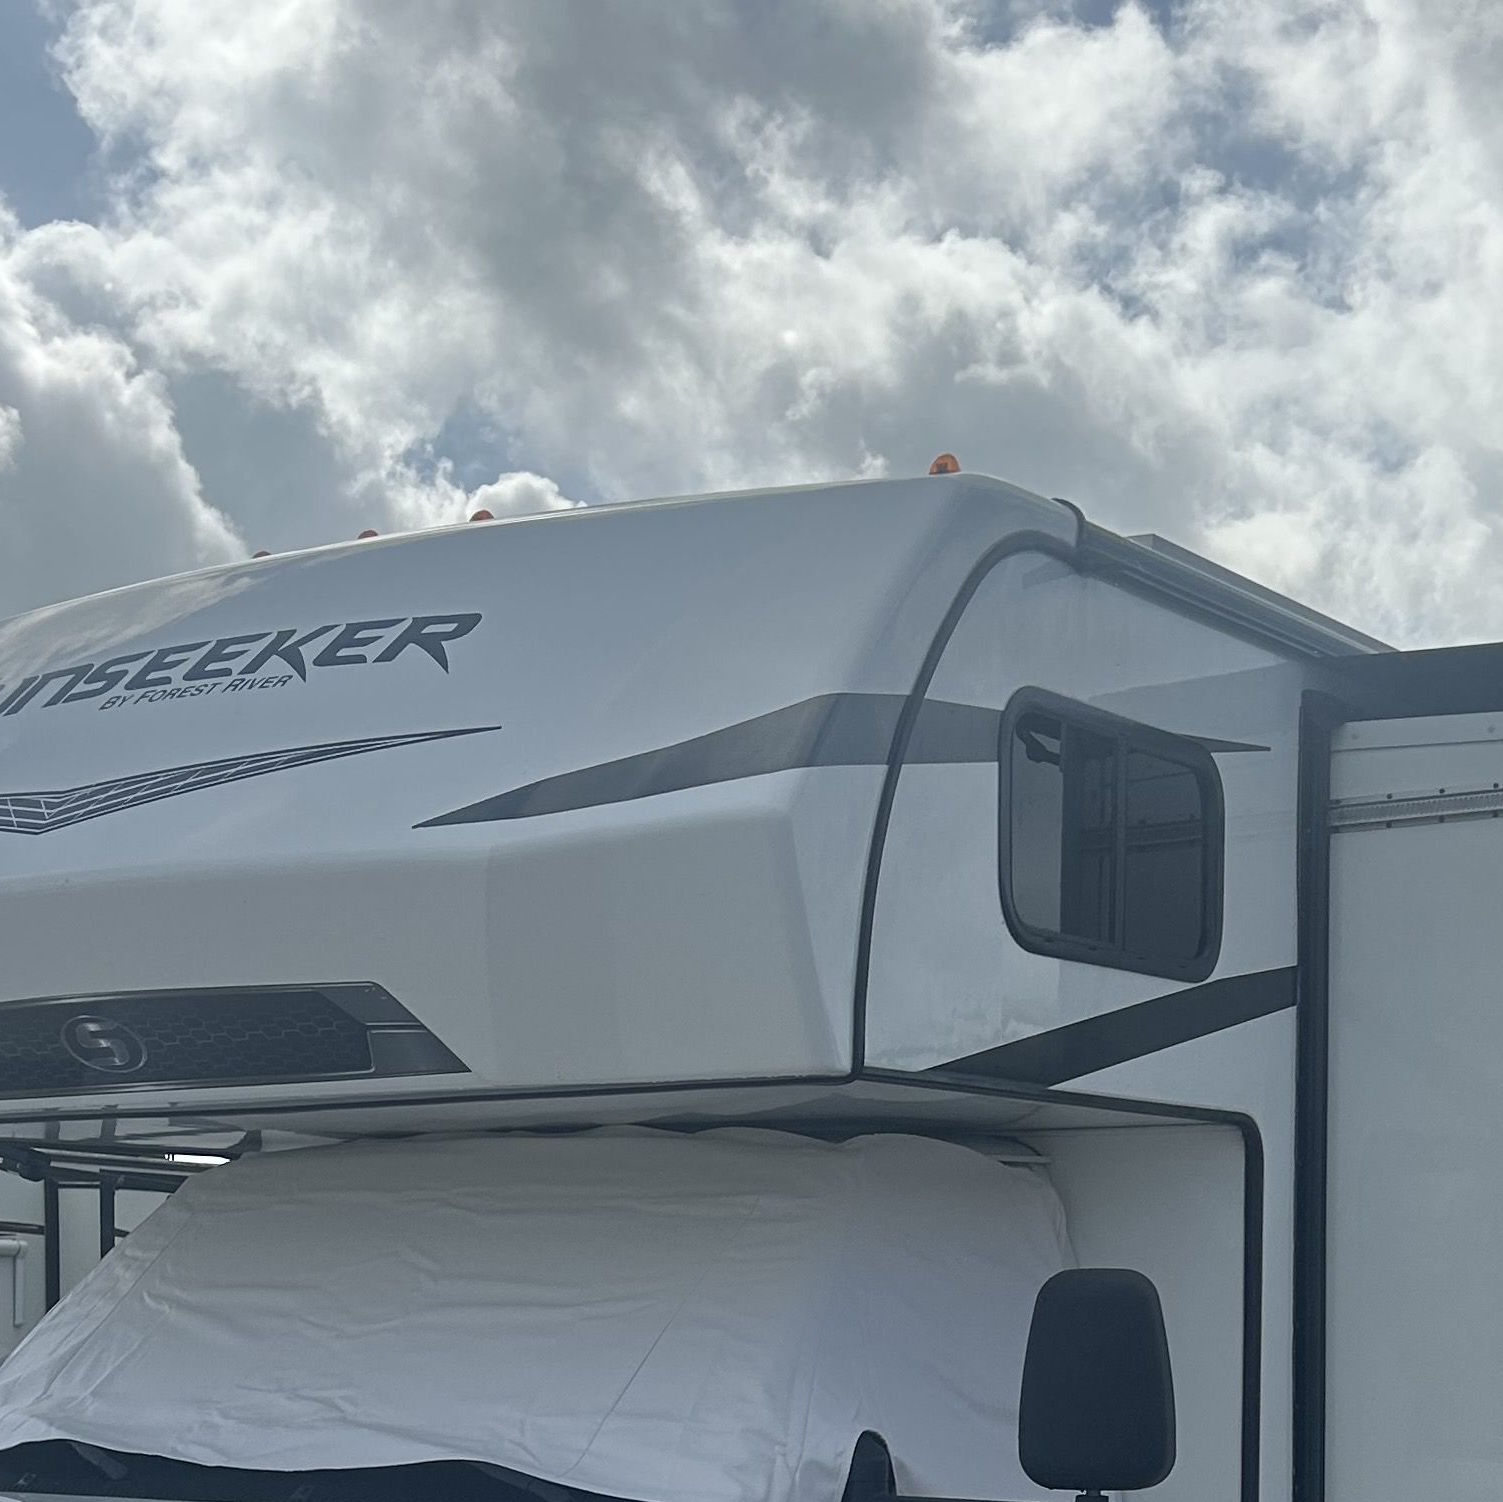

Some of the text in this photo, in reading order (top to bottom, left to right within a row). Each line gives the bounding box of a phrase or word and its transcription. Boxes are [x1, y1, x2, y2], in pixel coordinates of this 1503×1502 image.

[98, 674, 295, 711] BY FOREST RIVER
